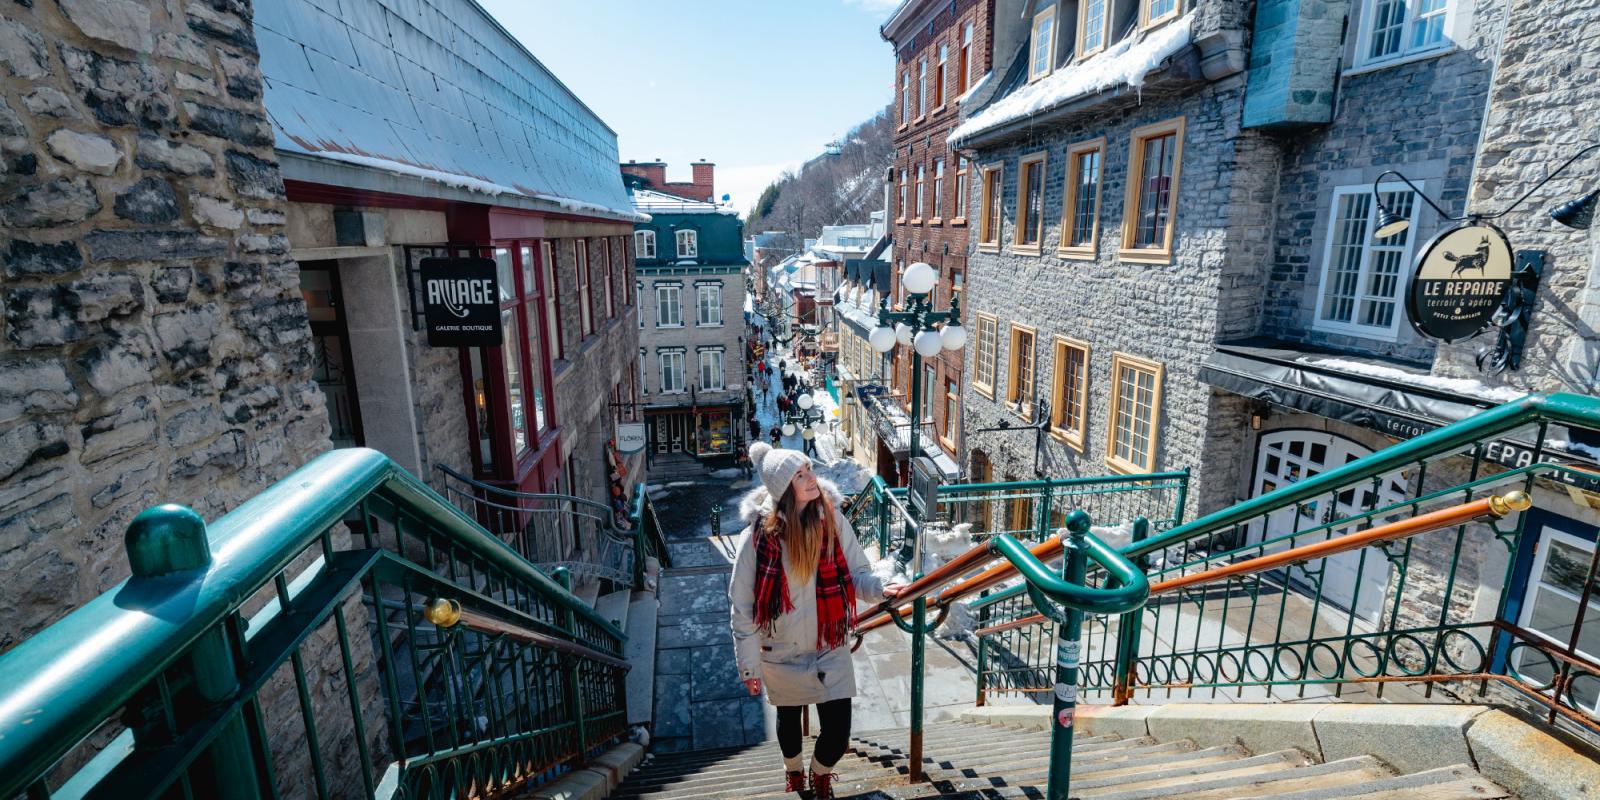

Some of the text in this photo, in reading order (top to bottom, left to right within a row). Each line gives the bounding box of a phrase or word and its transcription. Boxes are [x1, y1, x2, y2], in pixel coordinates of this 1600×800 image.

[1424, 282, 1503, 296] LE REPAIRE
[1427, 299, 1456, 307] terroir
[1459, 299, 1465, 307] &
[1433, 312, 1480, 320] PETIT CHAMPLAIN
[1387, 419, 1425, 437] terroi
